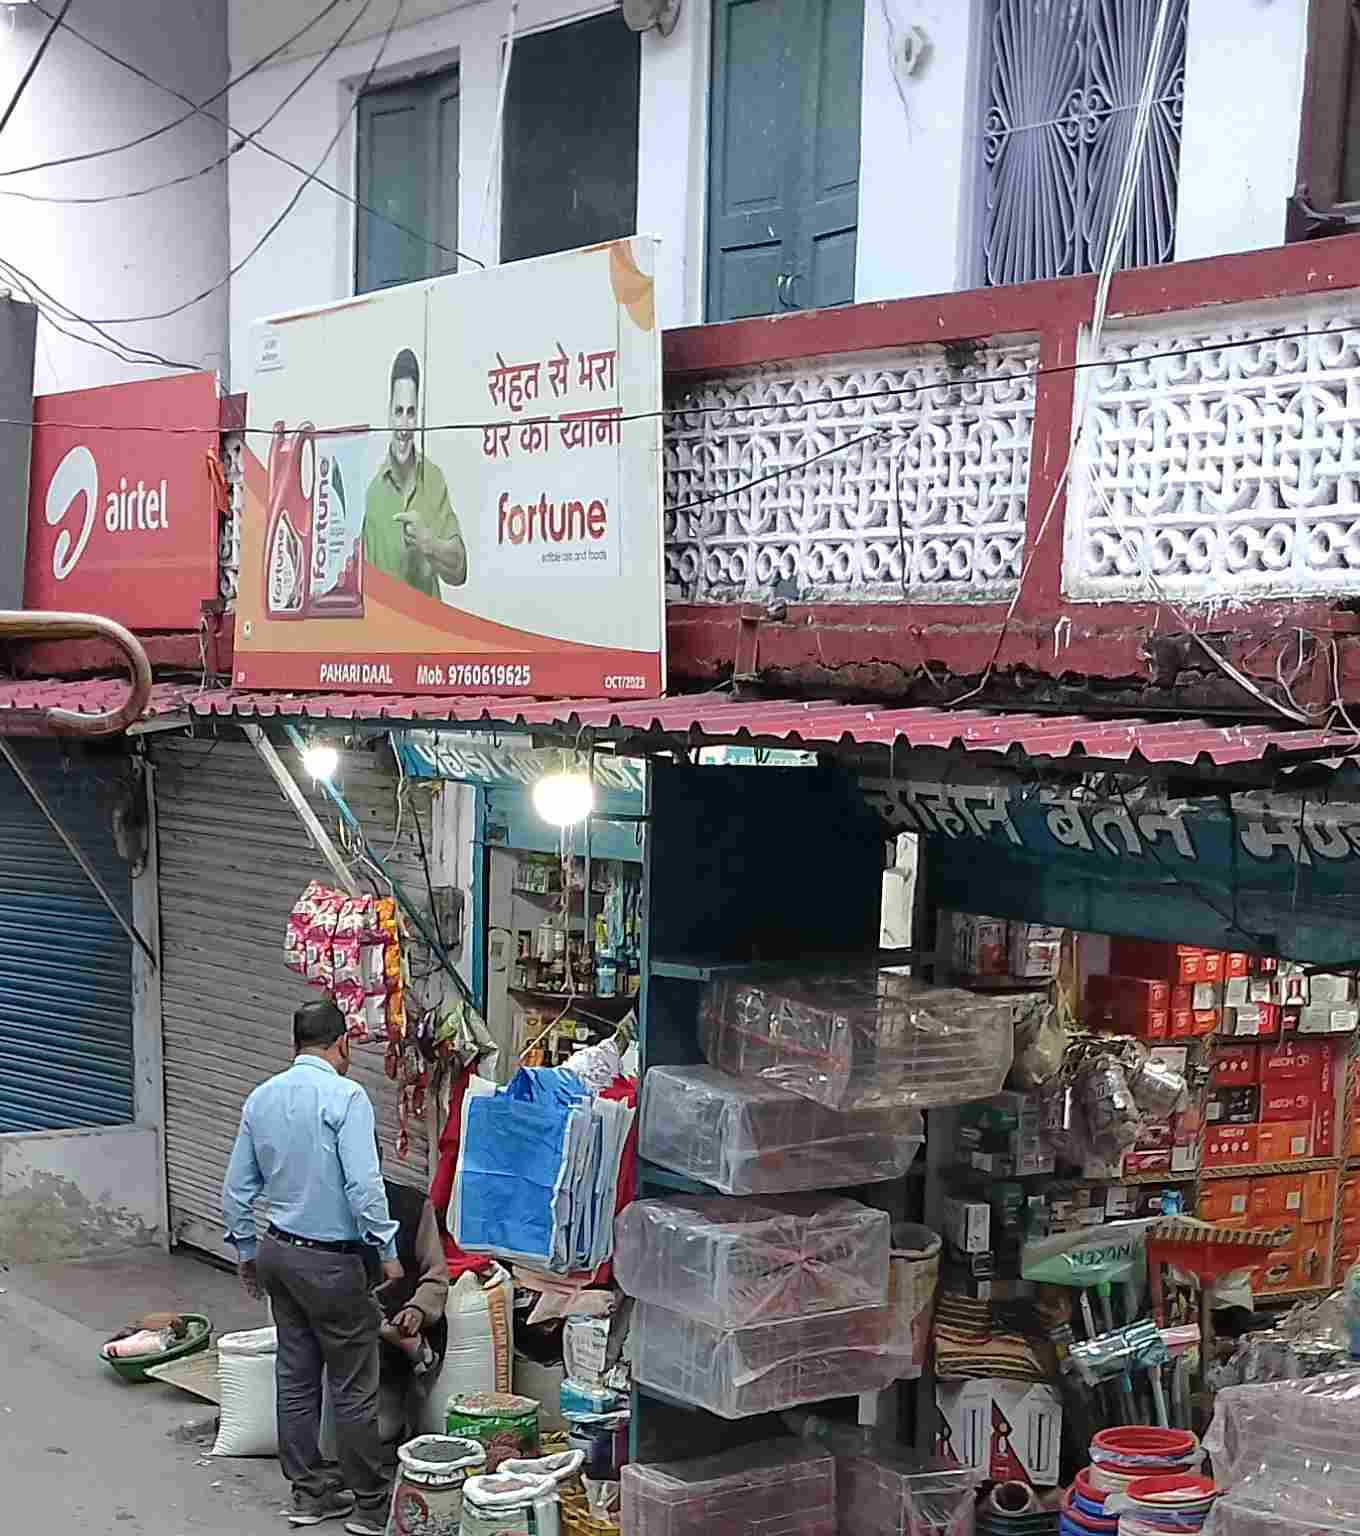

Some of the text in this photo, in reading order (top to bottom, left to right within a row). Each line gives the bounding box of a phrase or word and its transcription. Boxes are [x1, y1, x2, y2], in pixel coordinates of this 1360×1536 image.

[487, 341, 617, 412] सेहत से भरा
[480, 406, 623, 458] घर का खाना
[105, 476, 169, 532] airtel
[311, 456, 331, 581] fortune
[498, 491, 607, 546] fortune
[319, 663, 393, 685] PAHARI DAAL
[416, 664, 531, 687] Mob. 9760619625
